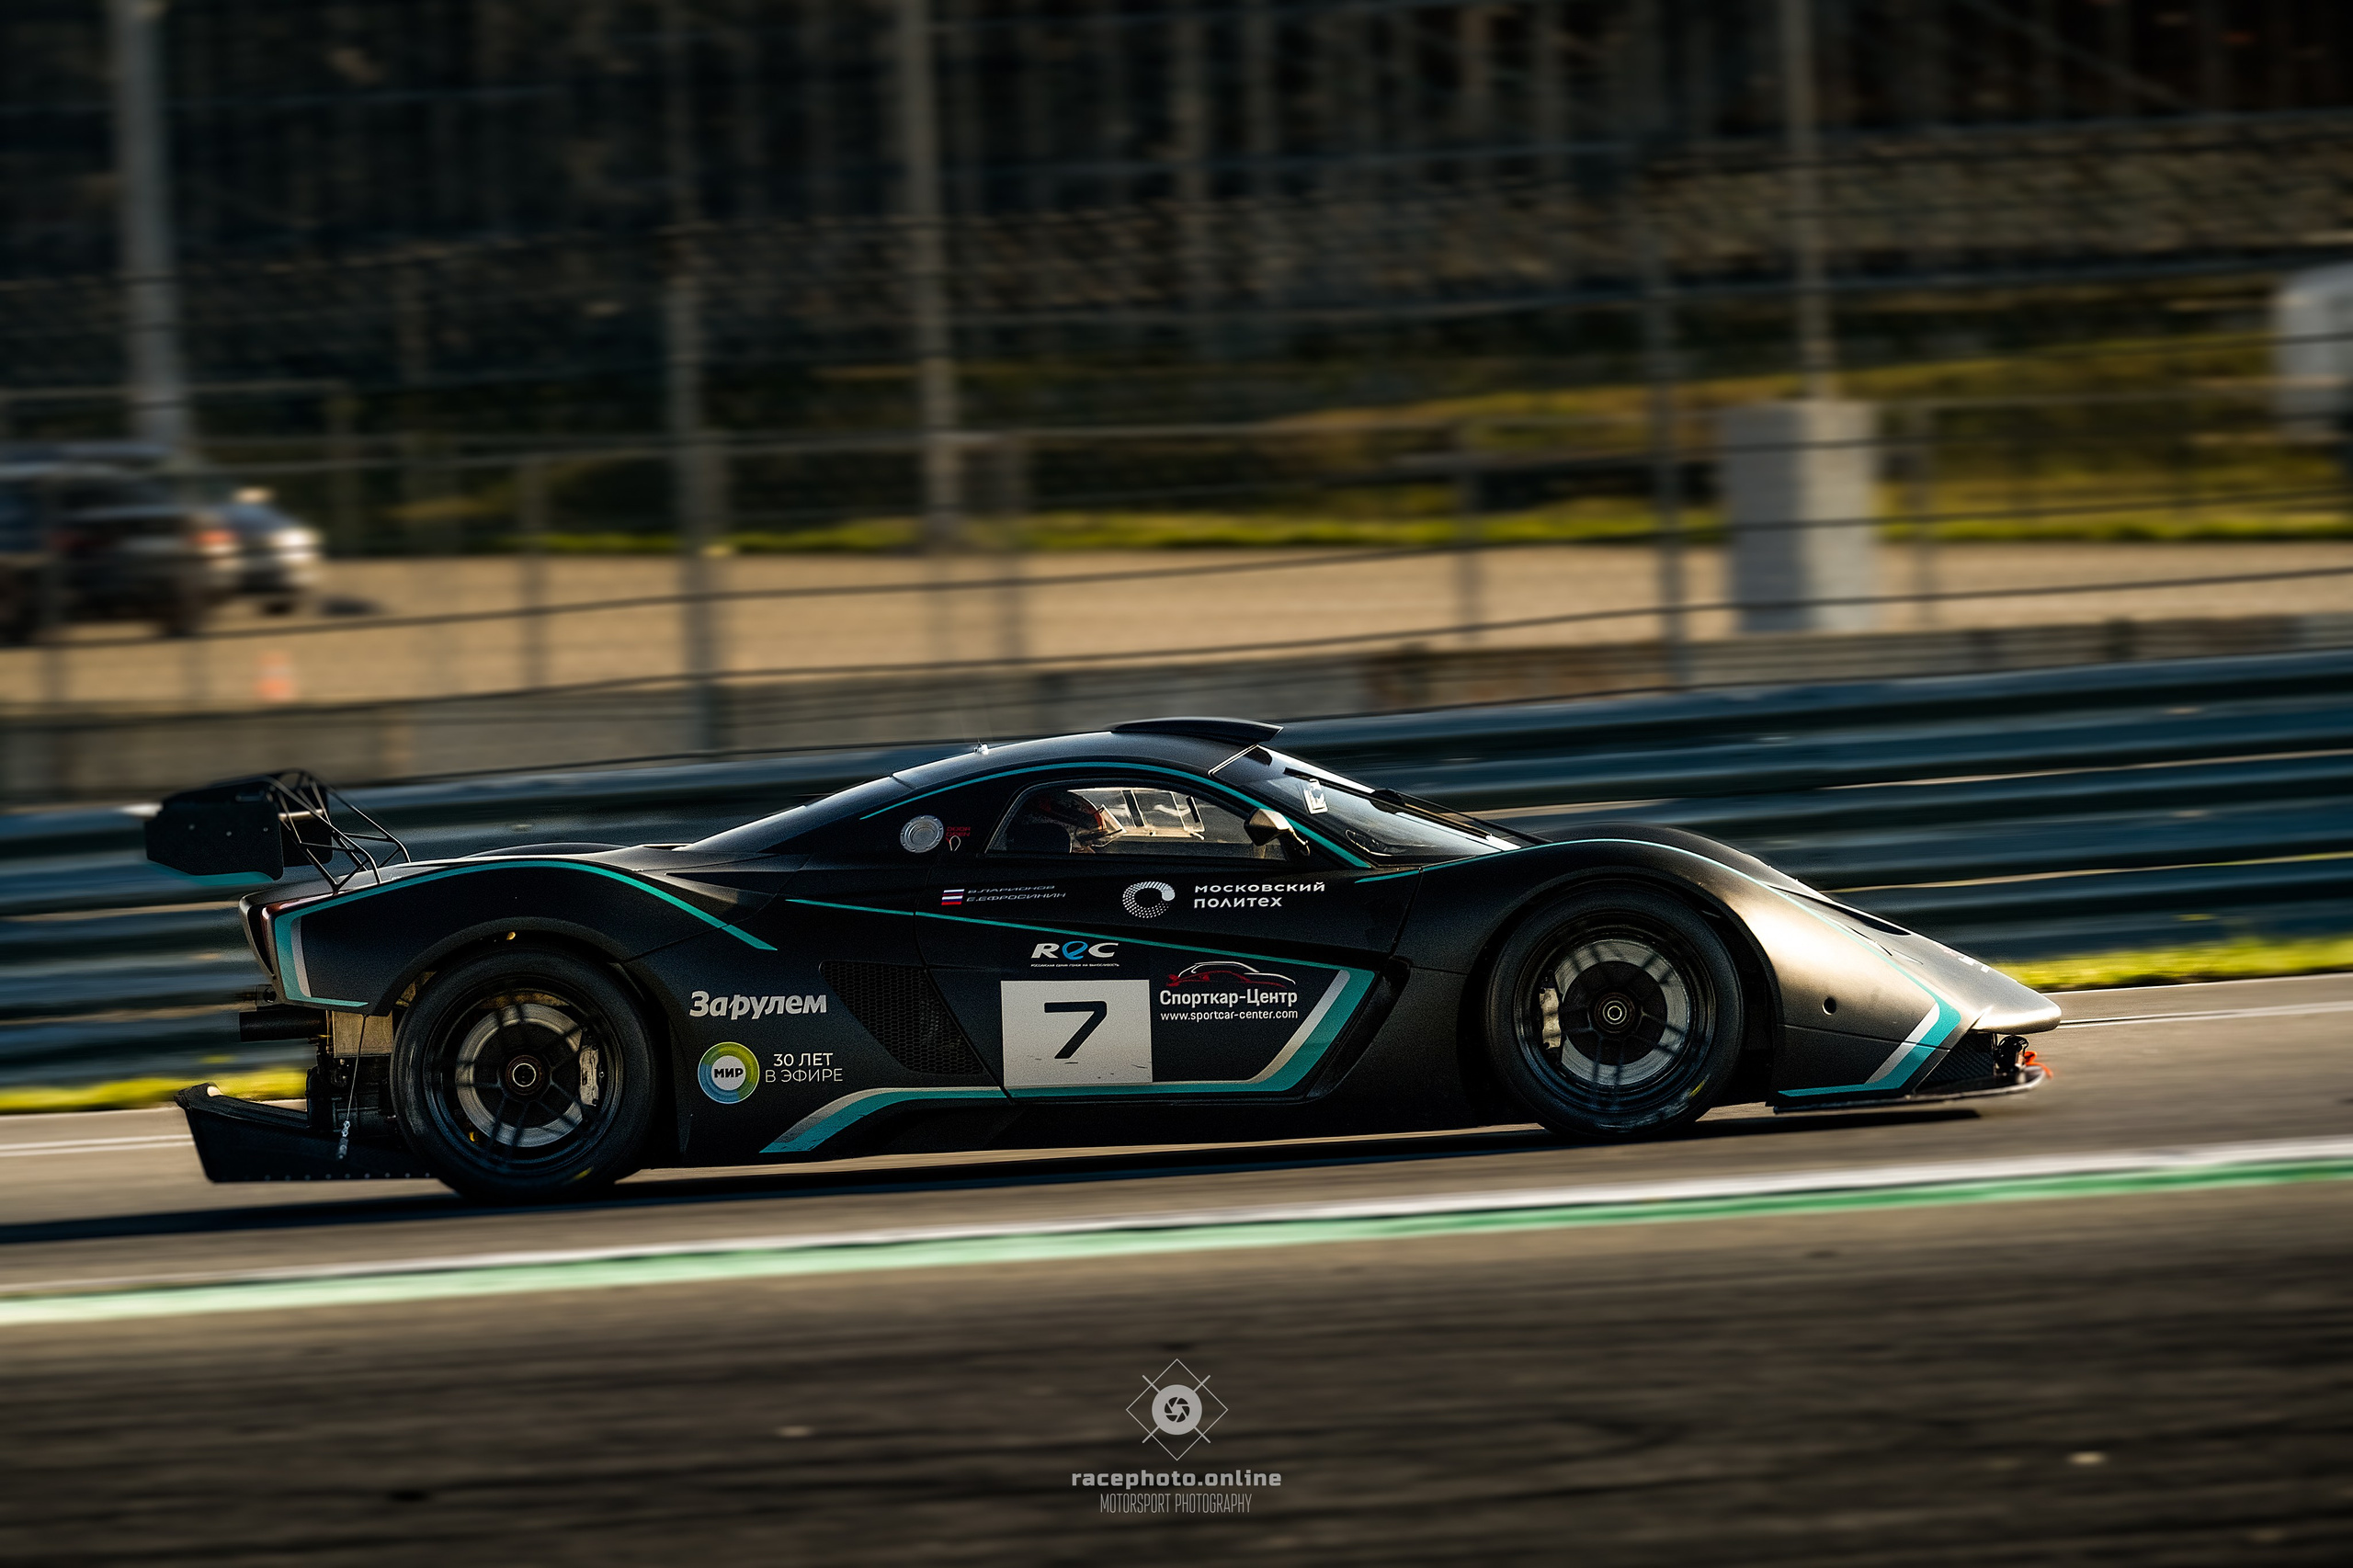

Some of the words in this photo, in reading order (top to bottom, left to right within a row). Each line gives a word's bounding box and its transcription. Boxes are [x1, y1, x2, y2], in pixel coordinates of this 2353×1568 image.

[1159, 988, 1298, 1008] Спорткар-Центр
[1160, 1010, 1299, 1022] www.sportcar-center.com
[1043, 1000, 1108, 1059] 7
[773, 1054, 794, 1067] 30
[798, 1052, 834, 1066] ЛЕТ
[713, 1068, 744, 1078] МИР
[765, 1069, 777, 1083] В
[781, 1068, 844, 1083] ЭФИРЕ
